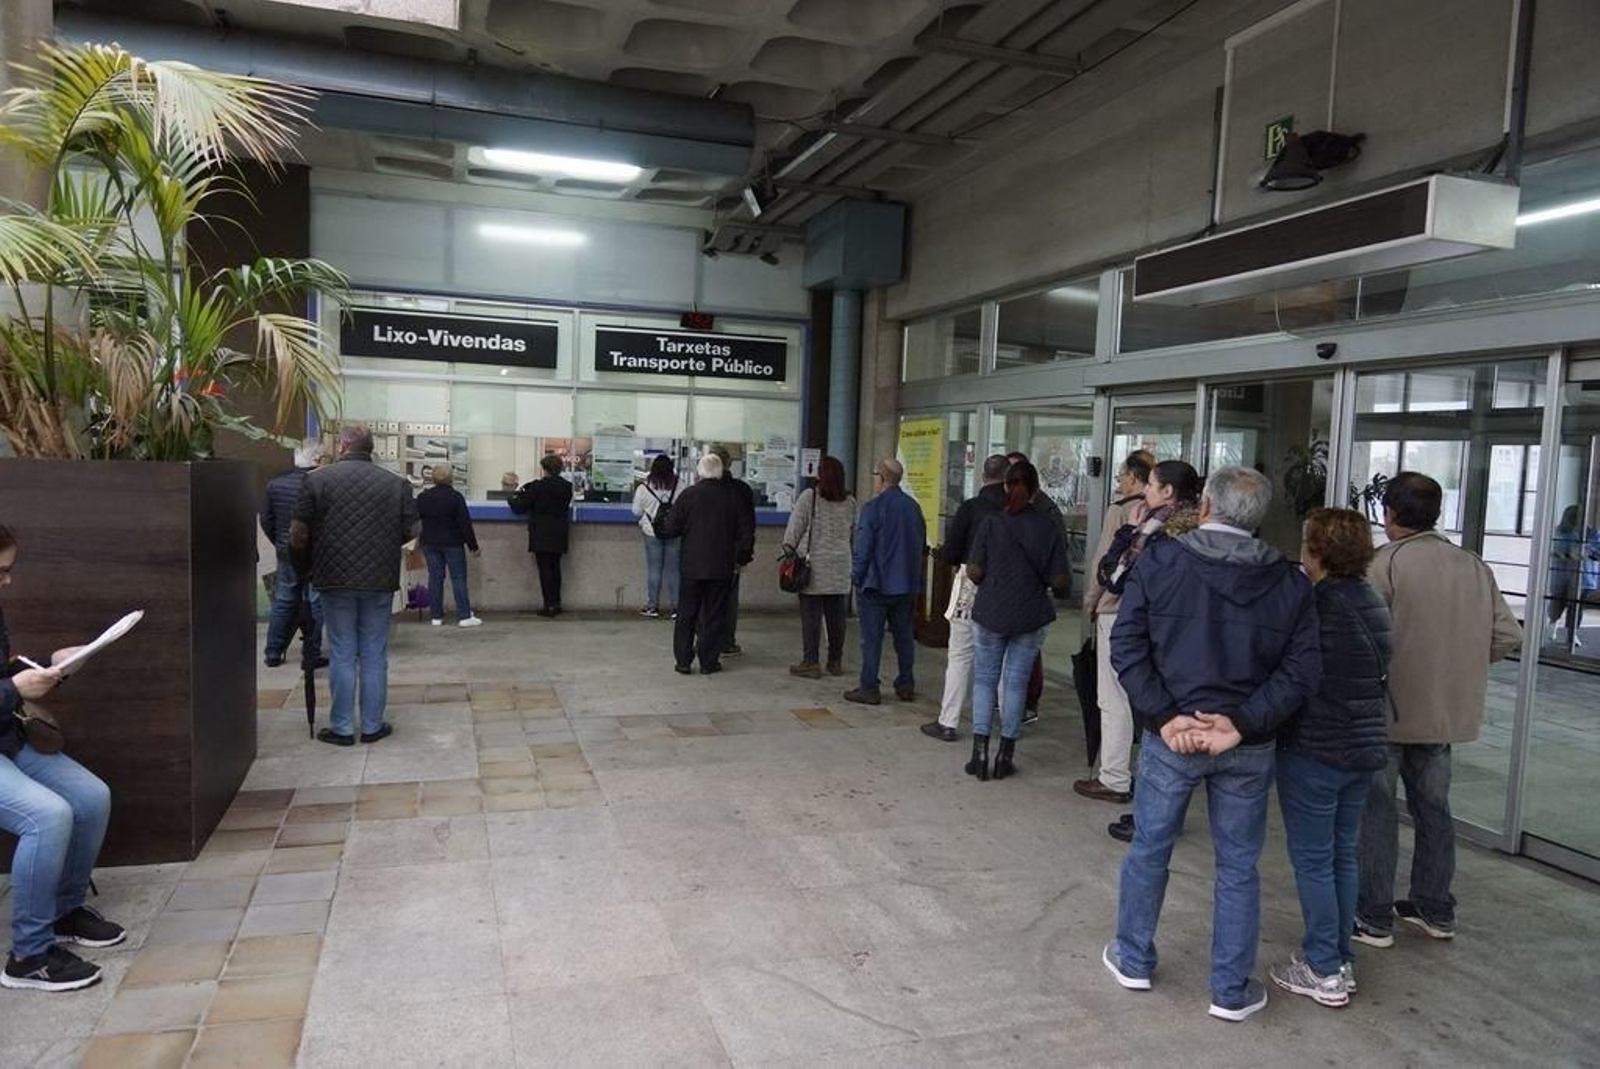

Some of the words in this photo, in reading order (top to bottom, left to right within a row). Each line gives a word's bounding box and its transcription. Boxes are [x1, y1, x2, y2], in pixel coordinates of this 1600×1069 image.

[373, 324, 527, 353] Lixo-Vivendas
[656, 336, 732, 357] Tarxetas
[609, 350, 707, 372] Transporte
[711, 356, 774, 376] Público
